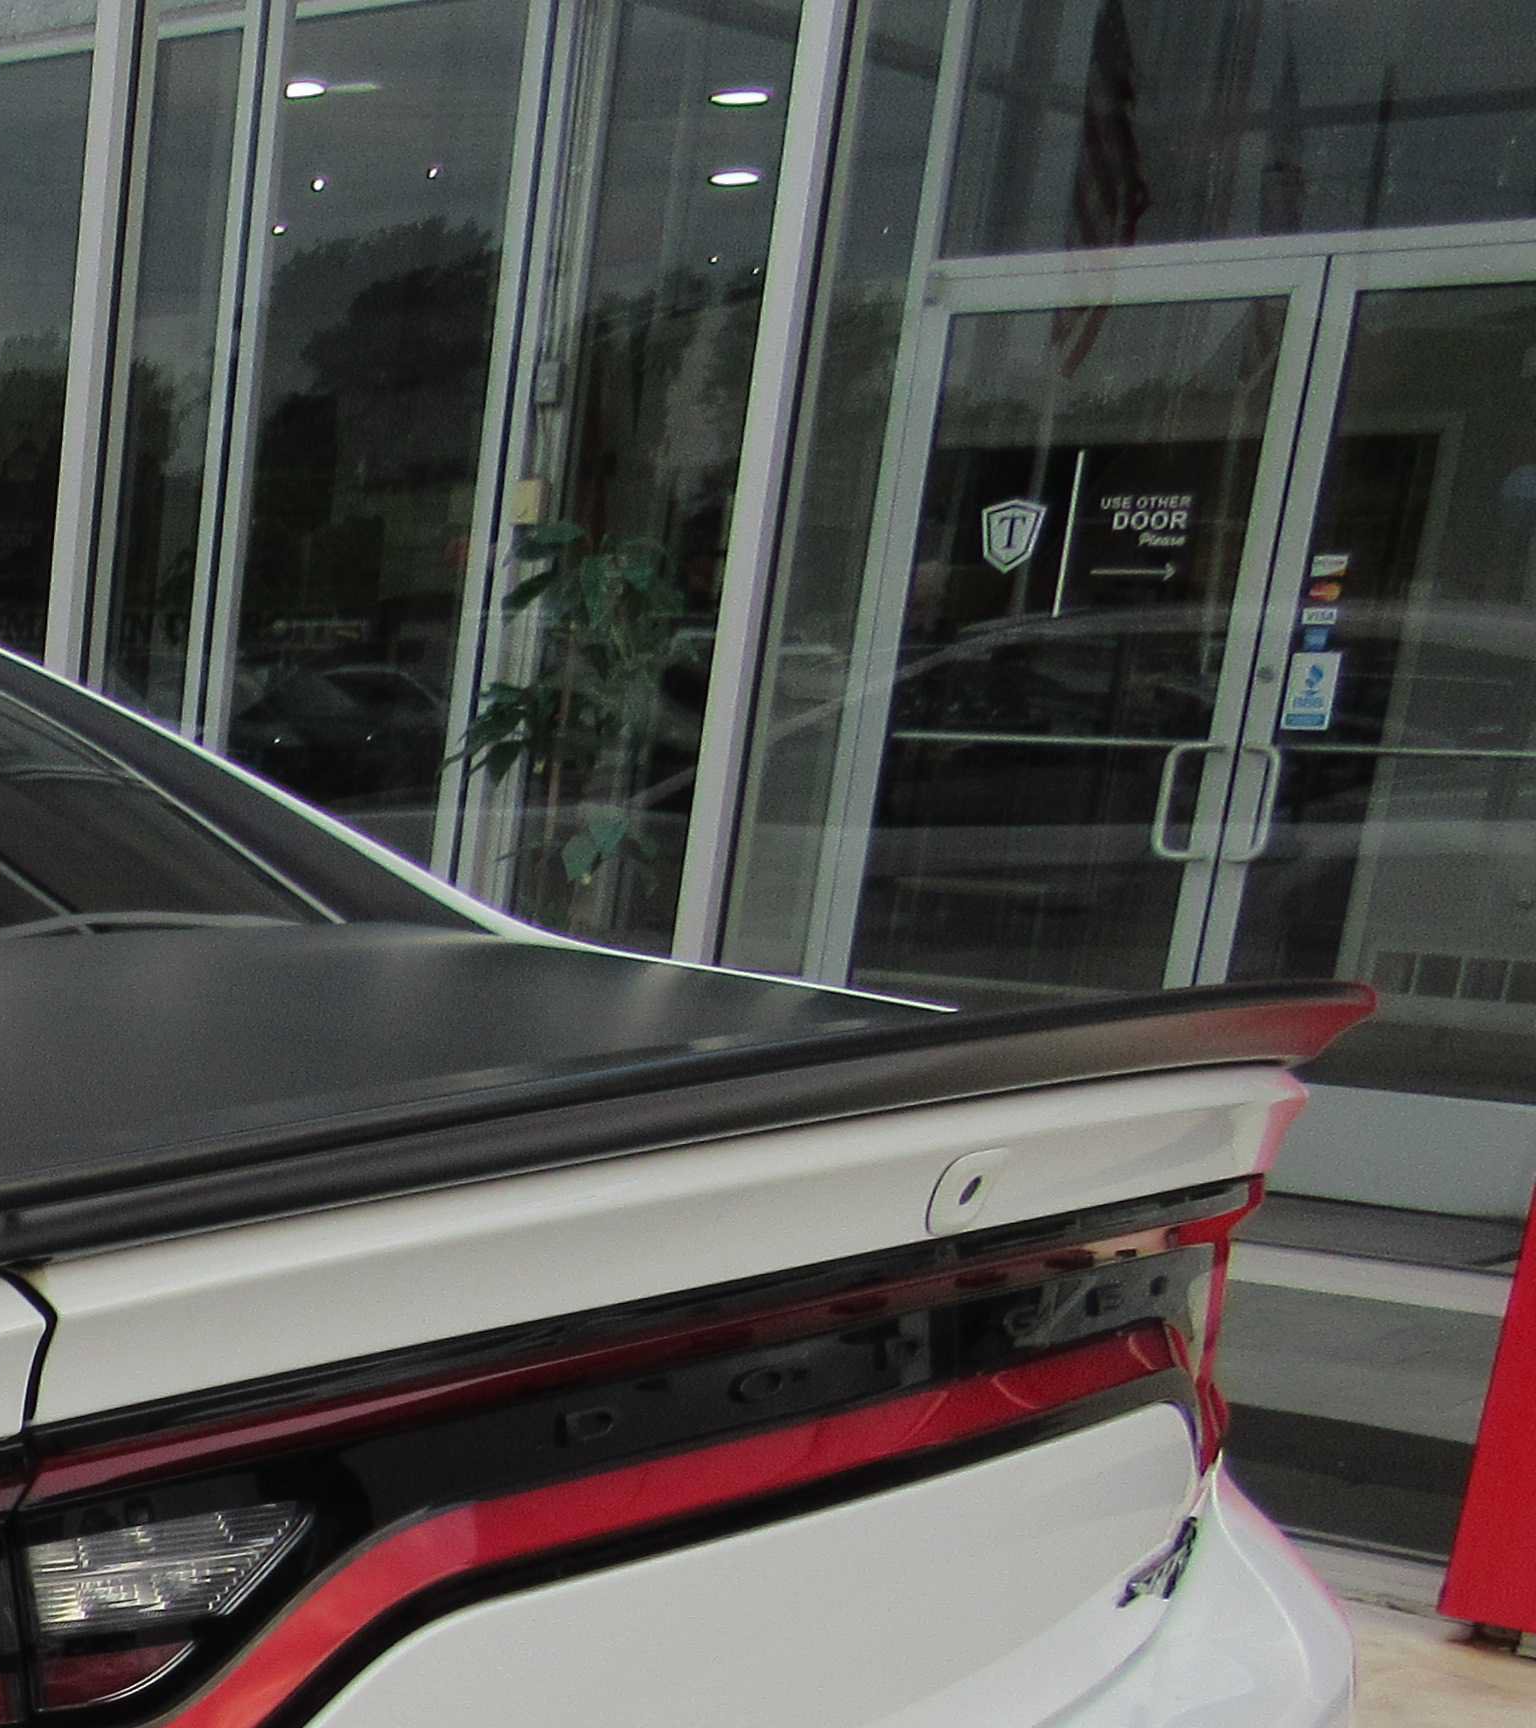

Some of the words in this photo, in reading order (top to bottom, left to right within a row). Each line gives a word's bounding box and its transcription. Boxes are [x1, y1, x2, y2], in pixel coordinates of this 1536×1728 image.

[1100, 496, 1132, 510] USE
[1135, 494, 1193, 509] OTHER
[1111, 510, 1189, 531] DOOR
[1136, 532, 1187, 548] Please
